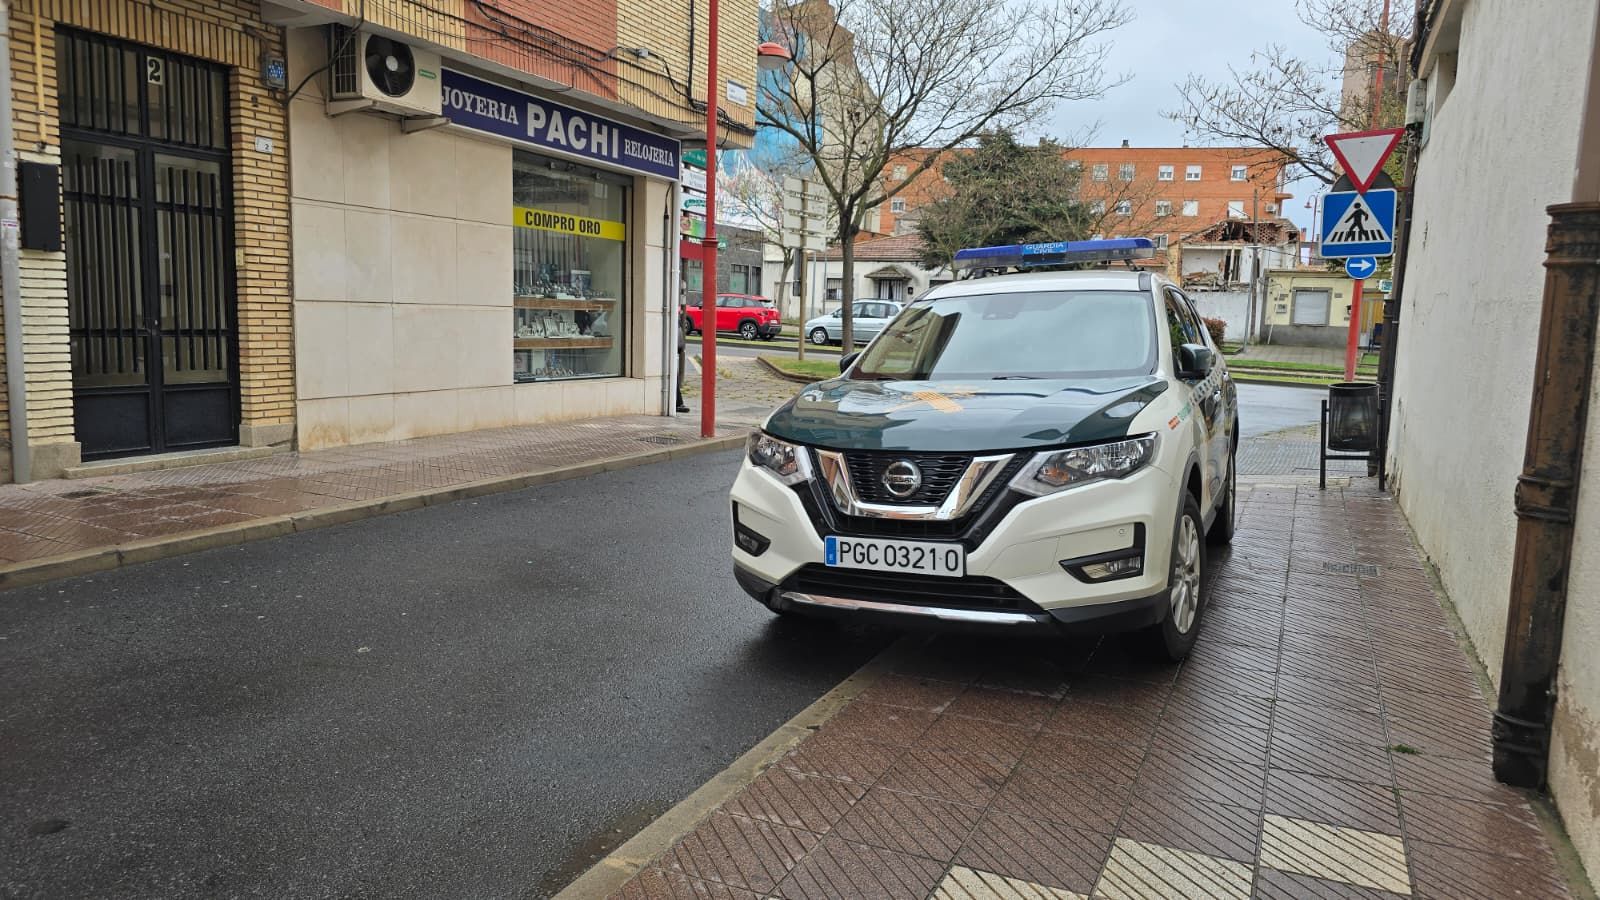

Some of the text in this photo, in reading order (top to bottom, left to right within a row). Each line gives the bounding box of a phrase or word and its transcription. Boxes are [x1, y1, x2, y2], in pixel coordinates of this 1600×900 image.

[148, 58, 161, 82] 2
[443, 86, 674, 167] JOYERIA PACHI RELOJERIA
[525, 211, 601, 235] COMPRO ORO
[1025, 242, 1064, 250] GUARDIA
[839, 541, 879, 565] PGC
